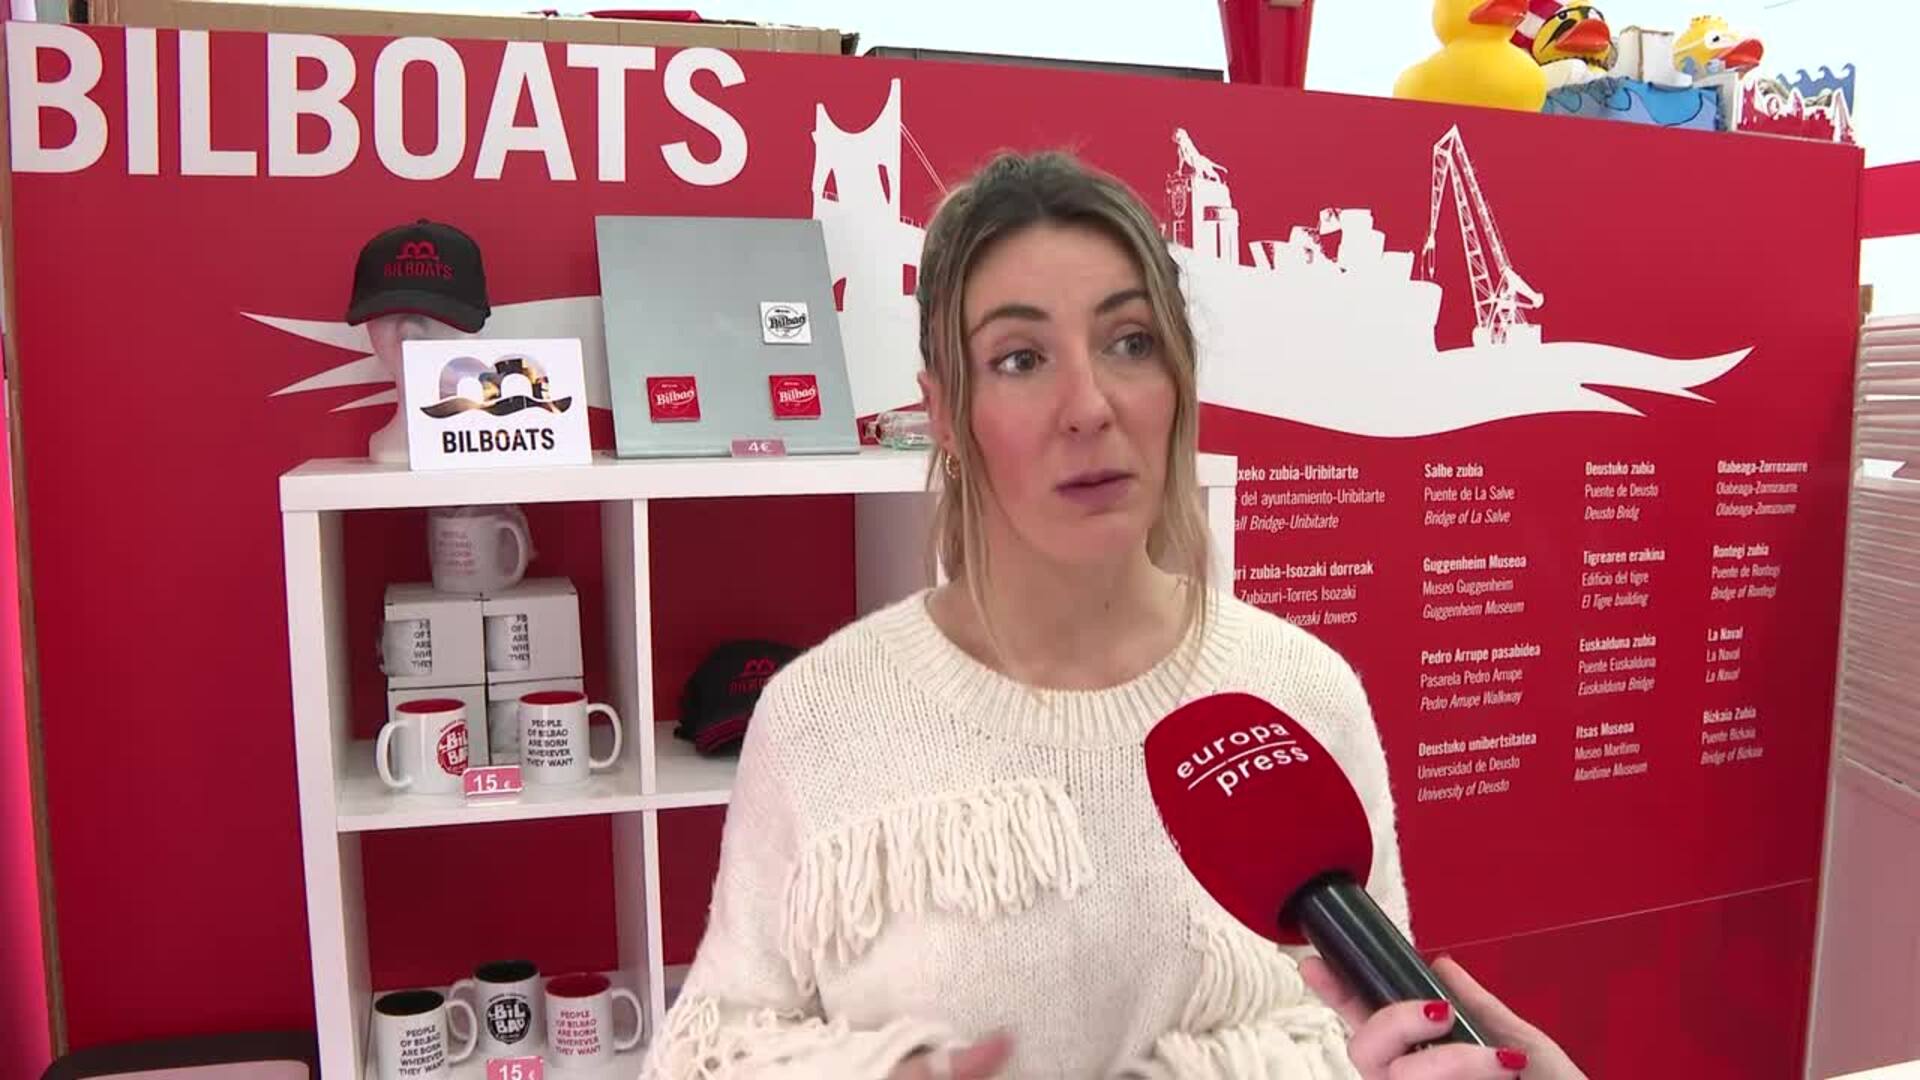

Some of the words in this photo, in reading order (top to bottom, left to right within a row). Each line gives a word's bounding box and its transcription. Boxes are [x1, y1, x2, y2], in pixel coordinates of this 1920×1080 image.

[5, 21, 749, 187] BILBOATS
[384, 261, 453, 279] BILBOATS
[656, 387, 695, 406] Bilbao
[778, 385, 816, 403] Bilbao
[442, 428, 555, 454] BILBOATS
[748, 441, 771, 453] 4€
[1269, 465, 1359, 481] zubia-Uribitarte
[1424, 463, 1453, 478] Salbe
[1456, 463, 1484, 478] zubia
[1585, 461, 1629, 476] Deustuko
[1630, 461, 1655, 476] zubia
[1241, 491, 1257, 506] del
[1261, 489, 1385, 509] ayuntamiento-Uribitarte
[1424, 487, 1457, 501] Puente
[1460, 487, 1472, 501] de
[1475, 486, 1487, 500] La
[1489, 485, 1515, 500] Salve
[1584, 484, 1615, 499] Puente
[1617, 484, 1627, 498] de
[1629, 482, 1659, 497] Deusto
[1424, 510, 1456, 527] Bridge
[1458, 510, 1469, 524] of
[1471, 509, 1482, 524] La
[1484, 508, 1511, 523] Salve
[1584, 506, 1615, 520] Deusto
[1249, 515, 1339, 533] Bridge-Uribitarte
[1423, 555, 1486, 575] Guggenheim
[1489, 554, 1526, 569] Museoa
[1583, 550, 1626, 567] Tigrearen
[1628, 548, 1665, 563] eraikina
[1250, 562, 1327, 580] zubia-Isozaki
[1329, 560, 1374, 577] dorreak
[1582, 572, 1613, 587] Edificio
[1615, 571, 1627, 585] del
[1630, 570, 1649, 586] tigre
[1712, 565, 1738, 579] Puente
[1740, 565, 1750, 578] de
[1240, 587, 1318, 605] Zubizuri-Torres
[1321, 585, 1357, 601] Isozaki
[1423, 580, 1454, 597] Museo
[1456, 577, 1513, 596] Guggenheim
[1711, 586, 1736, 602] Bridge
[1581, 594, 1591, 609] El
[1593, 593, 1613, 610] Tigre
[1614, 592, 1649, 608] building
[1323, 610, 1358, 625] towers
[1423, 602, 1482, 621] Guggenheim
[1484, 600, 1525, 616] Museum
[1708, 628, 1718, 642] La
[1720, 626, 1743, 641] Naval
[1579, 637, 1630, 653] Euskalduna
[1632, 634, 1656, 649] zubia
[1421, 650, 1451, 665] Pedro
[1454, 648, 1489, 664] Arrupe
[1491, 643, 1541, 663] pasabidea
[1706, 649, 1716, 662] La
[1718, 647, 1740, 661] Naval
[1578, 659, 1608, 675] Puente
[1610, 656, 1656, 672] Euskalduna
[1420, 672, 1461, 688] Pasarela
[1464, 670, 1490, 685] Pedro
[1492, 667, 1523, 683] Arrupe
[1705, 670, 1715, 683] La
[1717, 668, 1740, 682] Naval
[1578, 680, 1626, 696] Euskalduna
[1628, 677, 1655, 693] Bridge
[1420, 696, 1447, 712] Pedro
[1449, 694, 1481, 710] Arrupe
[1483, 690, 1523, 706] Walkway
[531, 719, 563, 728] PEOPLE
[1576, 725, 1599, 739] Itsas
[1601, 722, 1634, 737] Museoa
[538, 728, 569, 738] BILBAO
[1176, 723, 1290, 779] europa
[1418, 739, 1466, 757] Deustuko
[1468, 733, 1537, 752] unibertsitatea
[1575, 745, 1603, 761] Museo
[548, 757, 573, 767] WANT
[1418, 760, 1472, 779] Universidad
[1475, 760, 1487, 773] de
[1489, 756, 1520, 772] Deusto
[1216, 746, 1309, 797] press
[473, 774, 497, 791] 15
[1417, 783, 1464, 803] University
[1465, 782, 1477, 796] of
[1477, 779, 1510, 795] Deusto
[560, 1010, 590, 1019] PEOPLE
[567, 1018, 597, 1028] BILBAO
[406, 1024, 436, 1037] PEOPLE
[496, 1018, 525, 1034] BAO
[557, 1029, 571, 1037] ARE
[573, 1027, 597, 1037] BORN
[400, 1038, 413, 1048] OF
[556, 1036, 599, 1047] WHEREVER
[400, 1050, 443, 1067] WHEREVER
[402, 1048, 418, 1058] ARE
[419, 1043, 441, 1055] BORN
[555, 1046, 574, 1056] THEY
[577, 1045, 601, 1056] WANT
[398, 1066, 422, 1077] THEY
[499, 1064, 522, 1080] 15
